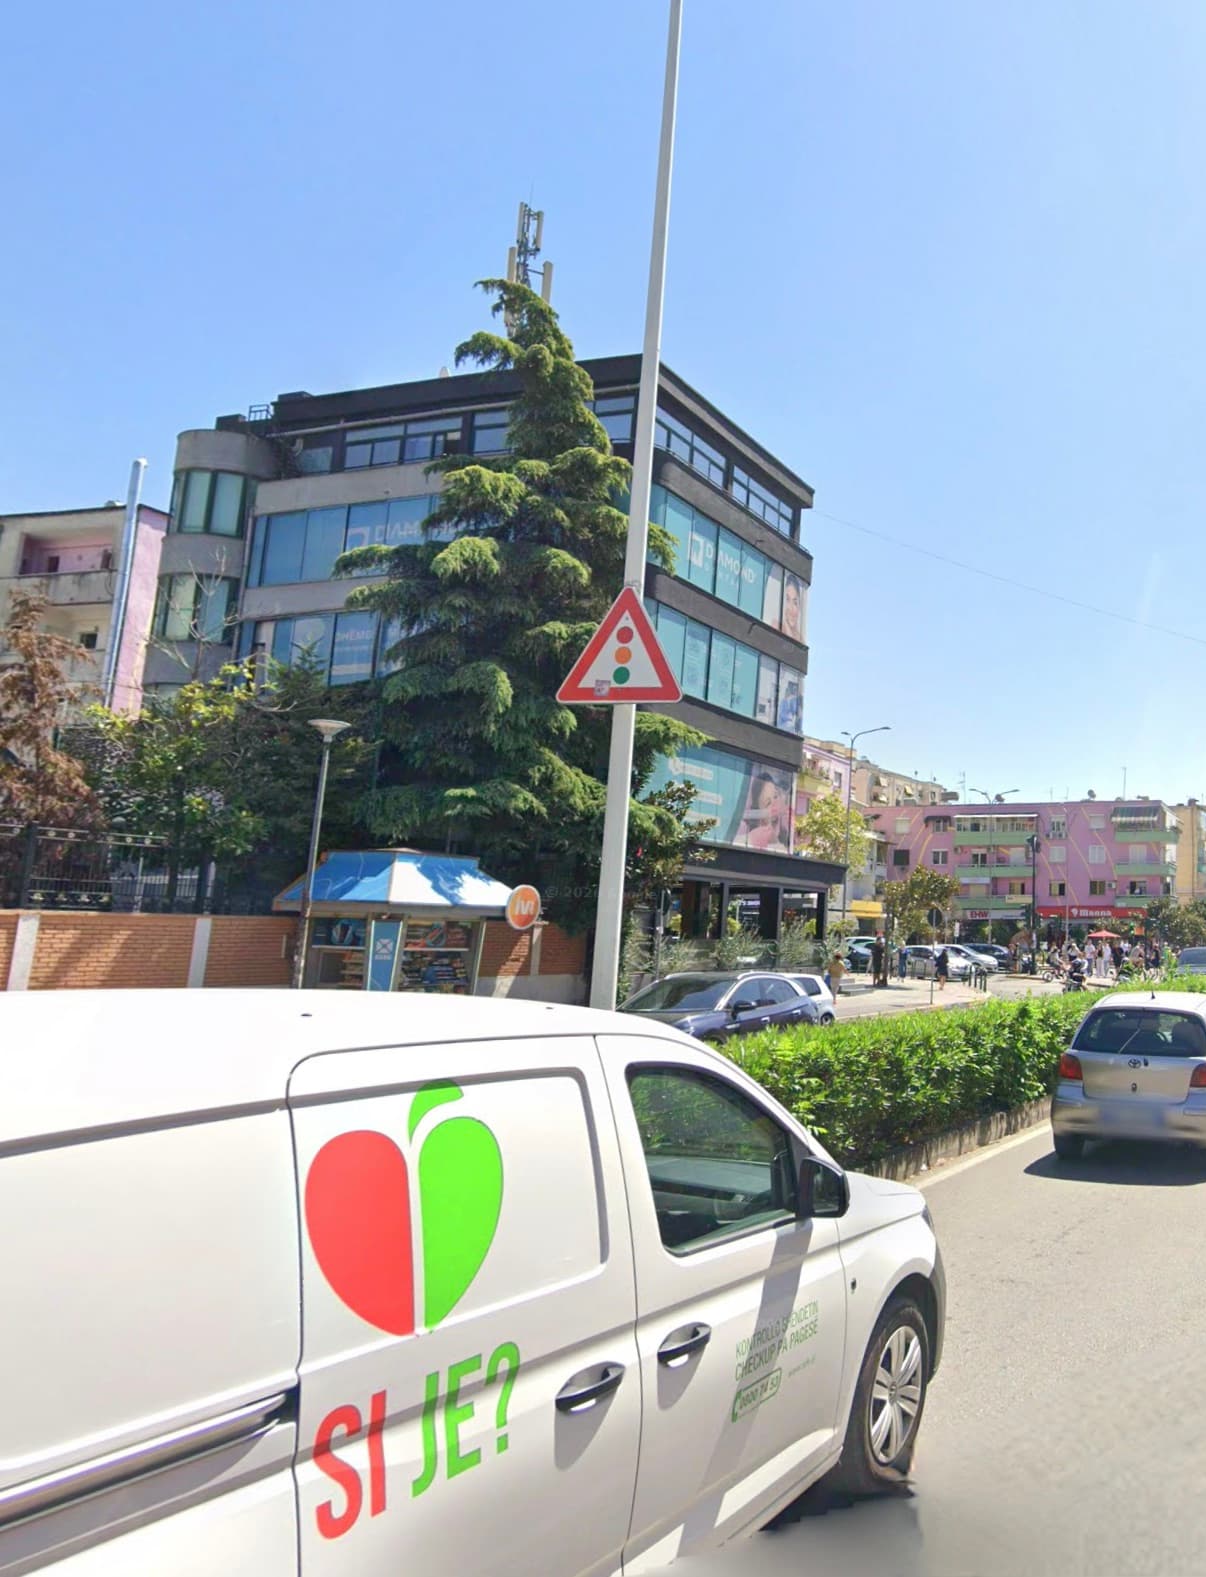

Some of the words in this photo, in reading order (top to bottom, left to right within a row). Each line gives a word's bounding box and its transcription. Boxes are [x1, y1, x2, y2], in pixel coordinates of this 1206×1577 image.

[705, 543, 755, 584] DAMOND
[311, 1389, 387, 1540] SI
[411, 1341, 521, 1498] JE?
